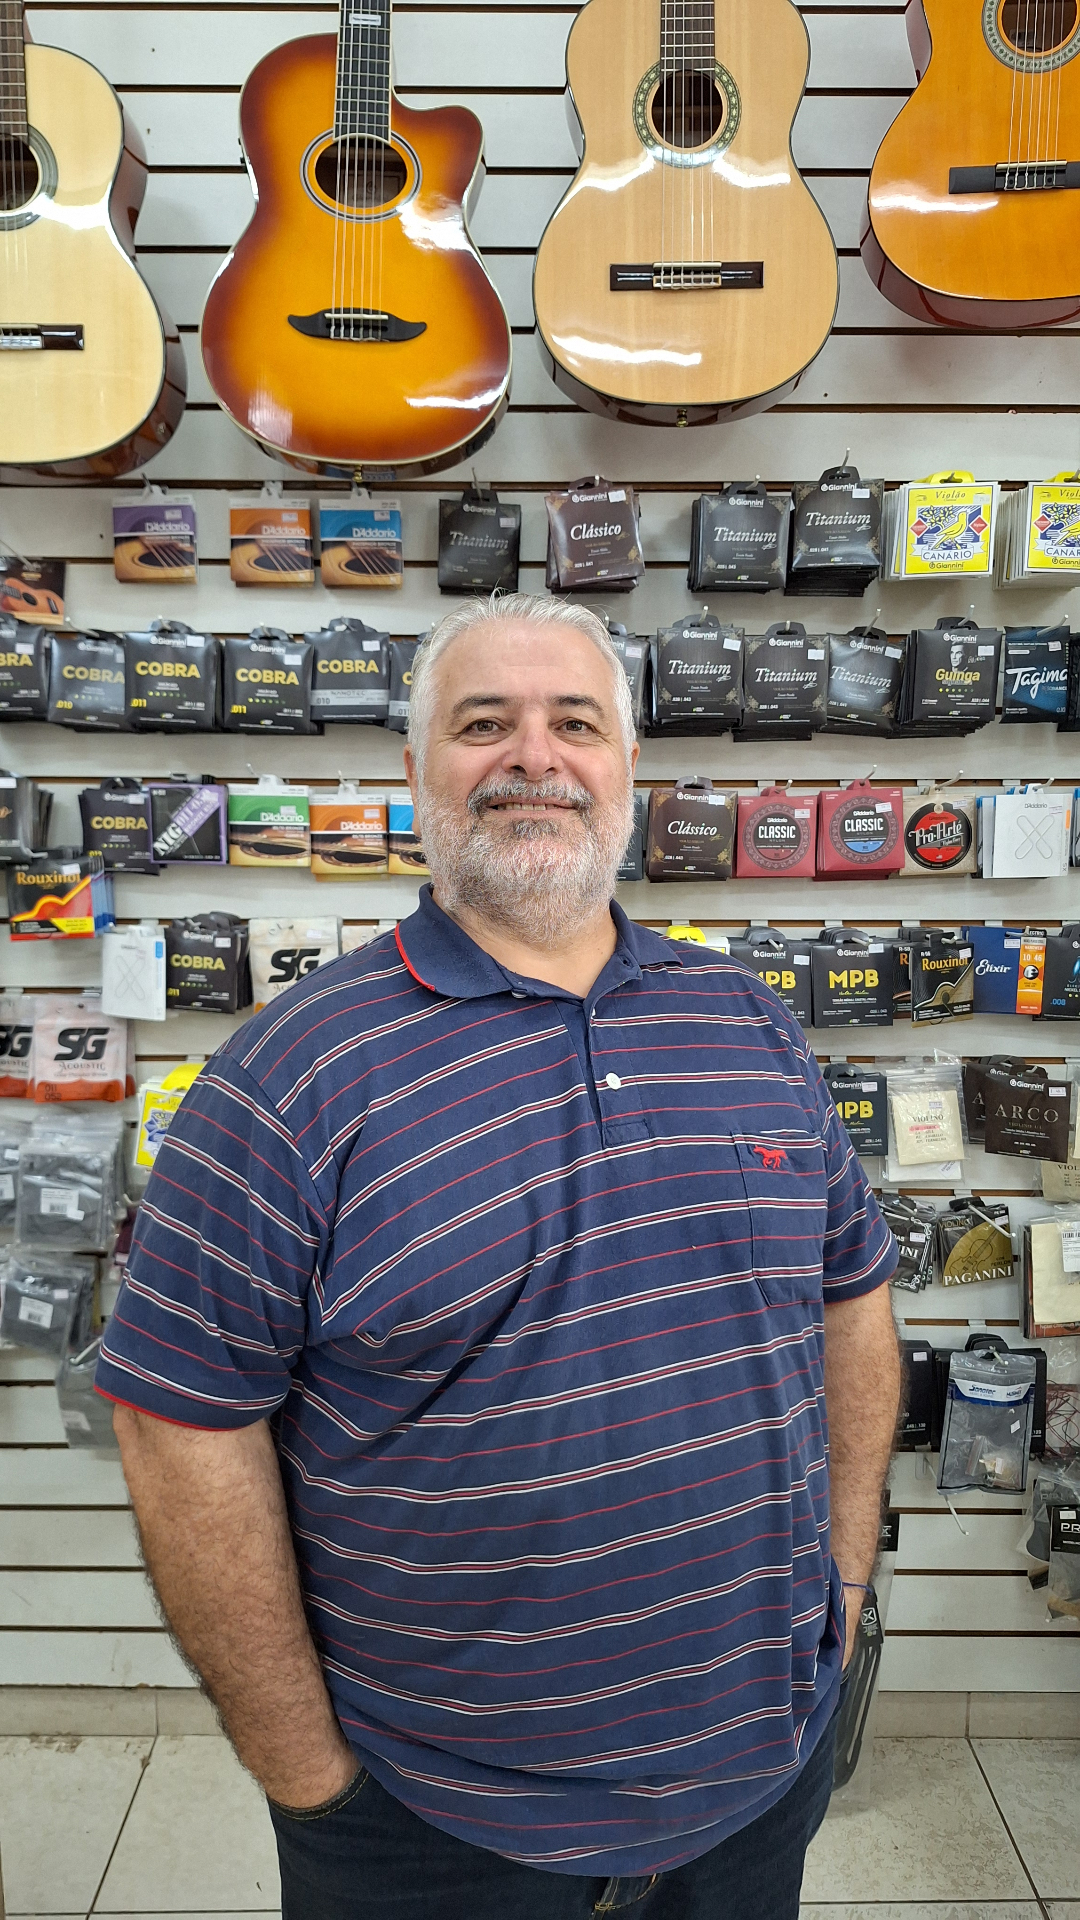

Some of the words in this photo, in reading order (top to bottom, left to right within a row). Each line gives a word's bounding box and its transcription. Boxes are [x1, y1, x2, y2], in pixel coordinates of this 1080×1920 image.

[828, 483, 858, 492] Giannini
[934, 489, 966, 500] Violão
[579, 492, 608, 502] Giannini
[735, 497, 765, 506] Giannini
[805, 511, 871, 527] Titanium
[262, 525, 306, 535] D'Addario
[352, 527, 397, 538] D'Addario
[570, 522, 622, 540] Clássico
[713, 526, 777, 543] Titanium
[449, 530, 509, 549] Titanium
[922, 549, 972, 561] CANÁRIO
[935, 561, 965, 569] Giannini
[157, 637, 187, 647] Giannini
[690, 631, 718, 640] Giannini
[950, 635, 977, 643] Giannini
[257, 644, 286, 654] Giannini
[776, 639, 805, 647] Giannini
[856, 643, 885, 653] Giannini
[135, 660, 202, 679] COBRA
[316, 659, 379, 674] COBRA
[668, 659, 732, 675] Titanium
[62, 664, 125, 684] COBRA
[235, 667, 300, 685] COBRA
[754, 667, 818, 683] Titanium
[829, 665, 892, 688] Titanium
[935, 668, 981, 684] Guinga
[1005, 667, 1068, 700] Tagima
[683, 793, 709, 801] Giannin
[91, 815, 149, 830] COBRA
[340, 821, 383, 831] D'Addario
[667, 820, 718, 836] Clássico
[844, 817, 884, 832] CLASSIC
[758, 825, 796, 839] CLASSIC
[16, 870, 81, 885] Rouxinol
[759, 950, 787, 958] Giannini
[843, 948, 870, 957] Giannini
[1022, 953, 1031, 962] 10
[1033, 953, 1043, 963] 46
[171, 953, 226, 971] COBRA
[268, 948, 322, 984] SG
[921, 955, 969, 972] Rouxinol
[975, 959, 1012, 976] Elixir
[828, 968, 880, 989] MPB
[1050, 998, 1067, 1006] .008
[53, 1027, 111, 1061] SG
[59, 1062, 106, 1073] ACOUSTIC
[44, 1084, 57, 1094] 011
[1017, 1080, 1046, 1090] Giannini
[912, 1113, 944, 1123] VIOLINO
[995, 1104, 1059, 1123] ARCO
[944, 1265, 1012, 1286] PAGANINI
